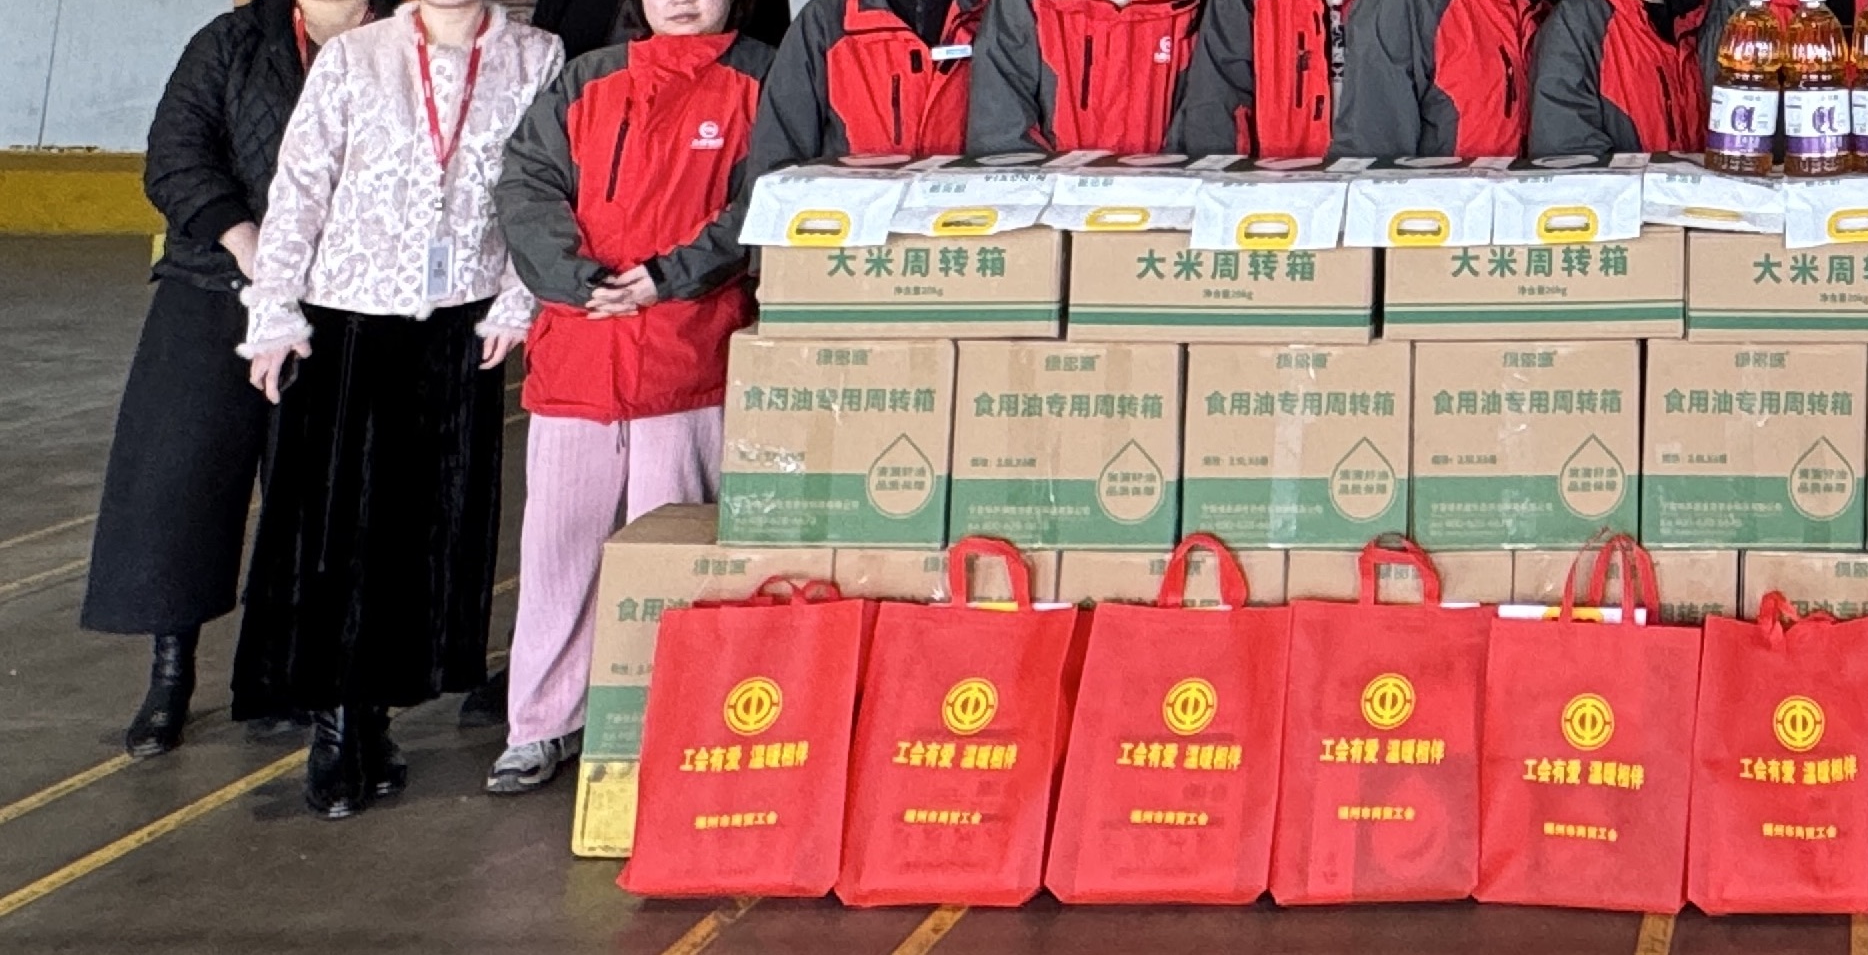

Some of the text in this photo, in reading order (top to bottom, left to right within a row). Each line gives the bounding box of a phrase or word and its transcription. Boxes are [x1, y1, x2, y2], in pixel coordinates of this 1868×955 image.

[827, 246, 1007, 278] 大米周转箱
[1136, 248, 1316, 283] 大米周转箱
[1452, 244, 1629, 278] 大米周转箱
[745, 386, 935, 412] 食用油专用周转箱
[975, 392, 1164, 418] 食用油专用周转箱
[1207, 391, 1395, 416] 食用油专用周转箱
[1434, 389, 1622, 414] 食用油专用周转箱
[1667, 389, 1854, 415] 食用油专用周转箱
